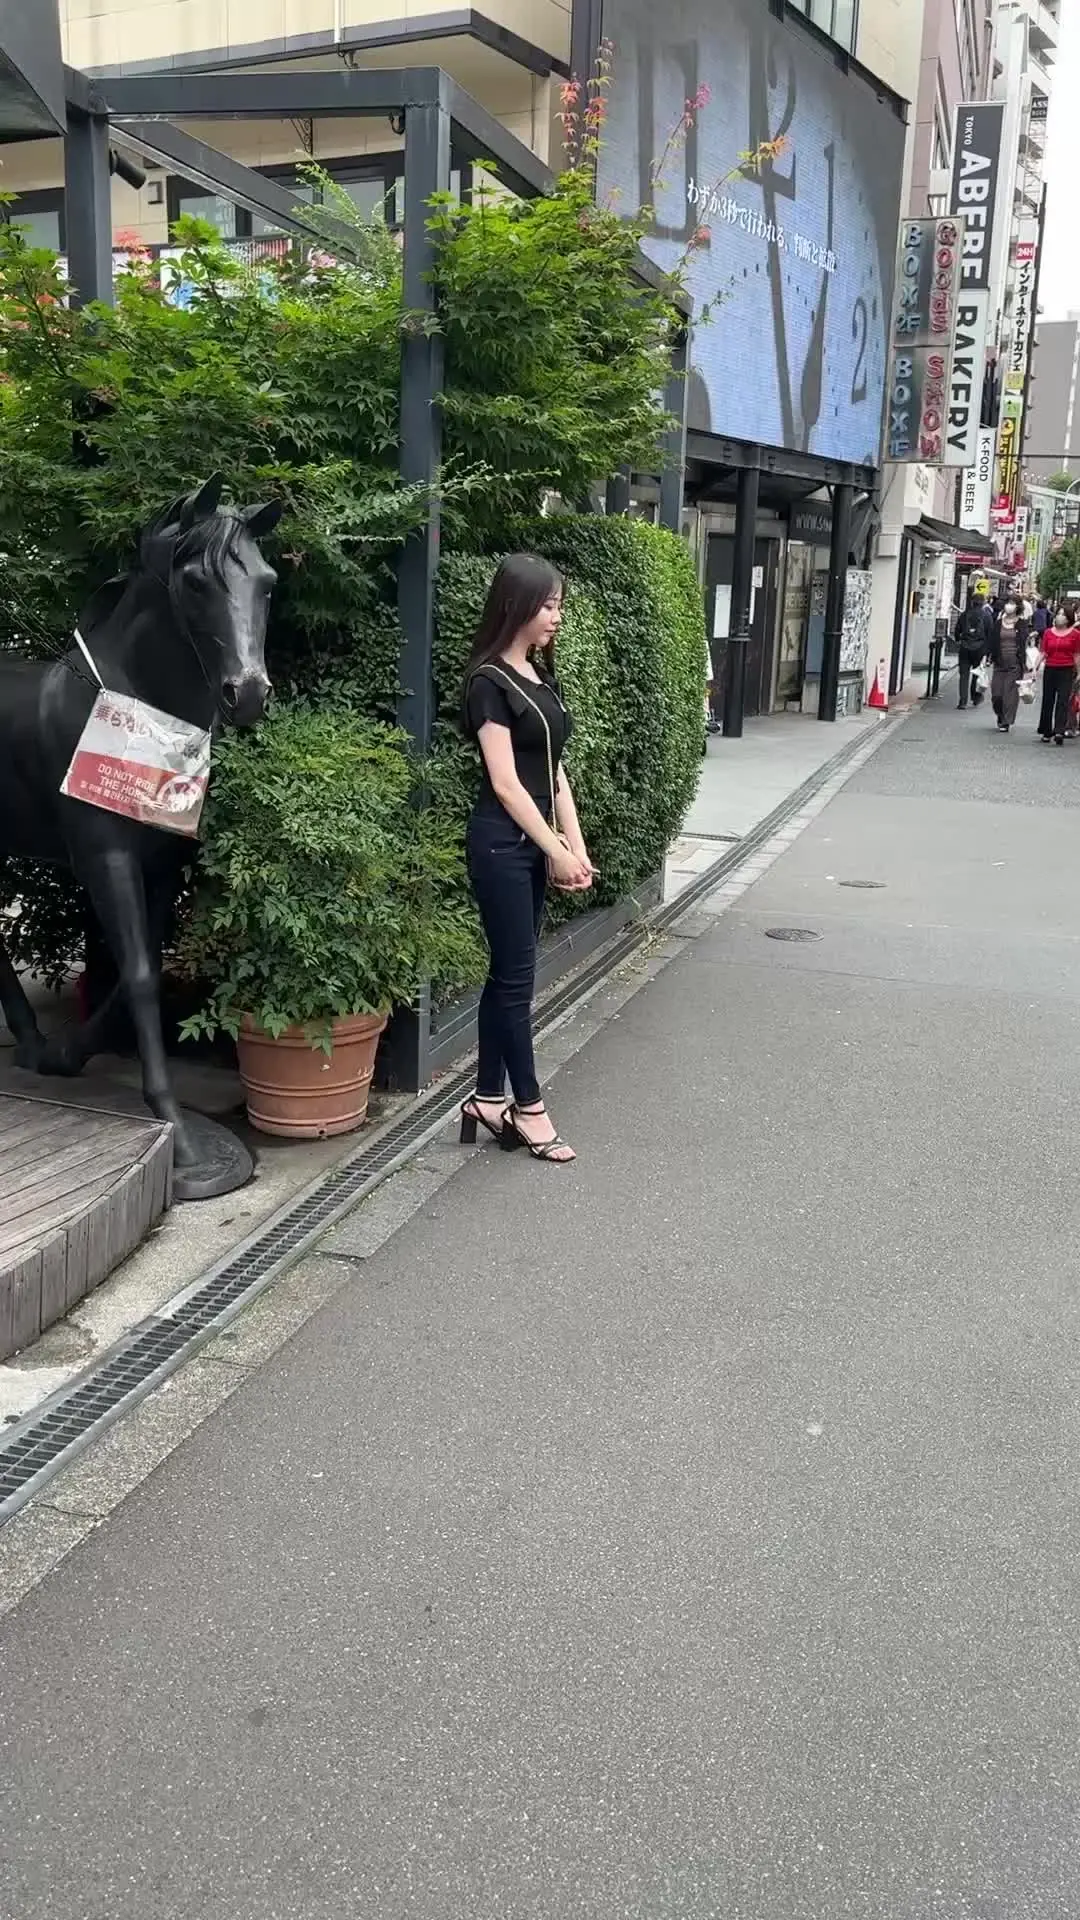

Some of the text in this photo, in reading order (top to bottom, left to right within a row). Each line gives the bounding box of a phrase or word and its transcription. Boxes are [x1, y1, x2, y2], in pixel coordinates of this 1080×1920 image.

[964, 115, 974, 146] TOKYO
[902, 223, 922, 307] BOX
[1017, 248, 1032, 257] 24H
[1012, 261, 1030, 371] インターネットカフェ
[892, 358, 912, 433] BOX
[979, 437, 990, 482] K-FOOD
[965, 471, 976, 512] & BEER
[97, 763, 112, 776] DO
[113, 769, 134, 784] NOT
[134, 776, 157, 794] RIDE
[100, 775, 120, 791] THE
